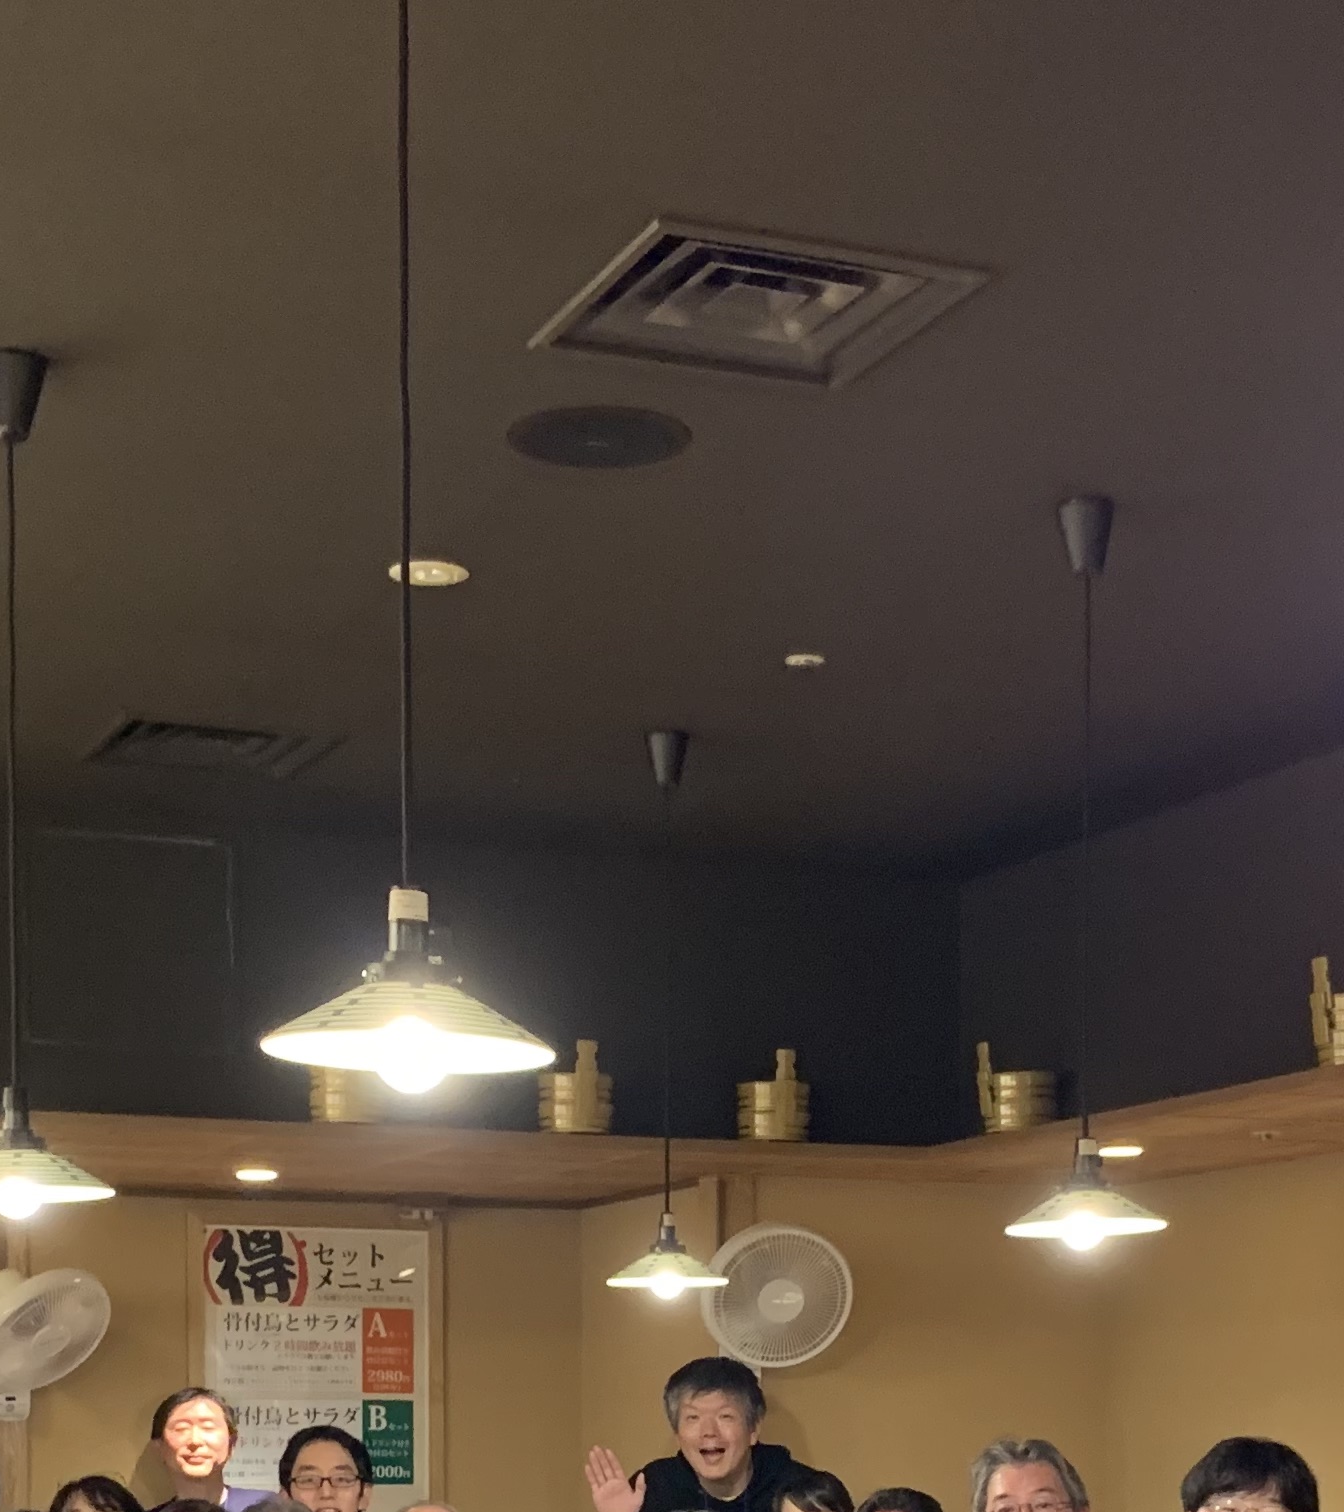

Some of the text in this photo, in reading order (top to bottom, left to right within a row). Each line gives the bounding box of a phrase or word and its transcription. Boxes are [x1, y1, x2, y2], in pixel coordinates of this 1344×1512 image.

[212, 1229, 297, 1304] 得
[313, 1242, 385, 1269] セット
[315, 1267, 414, 1293] メニュー
[367, 1311, 388, 1339] A
[368, 1404, 387, 1432] B
